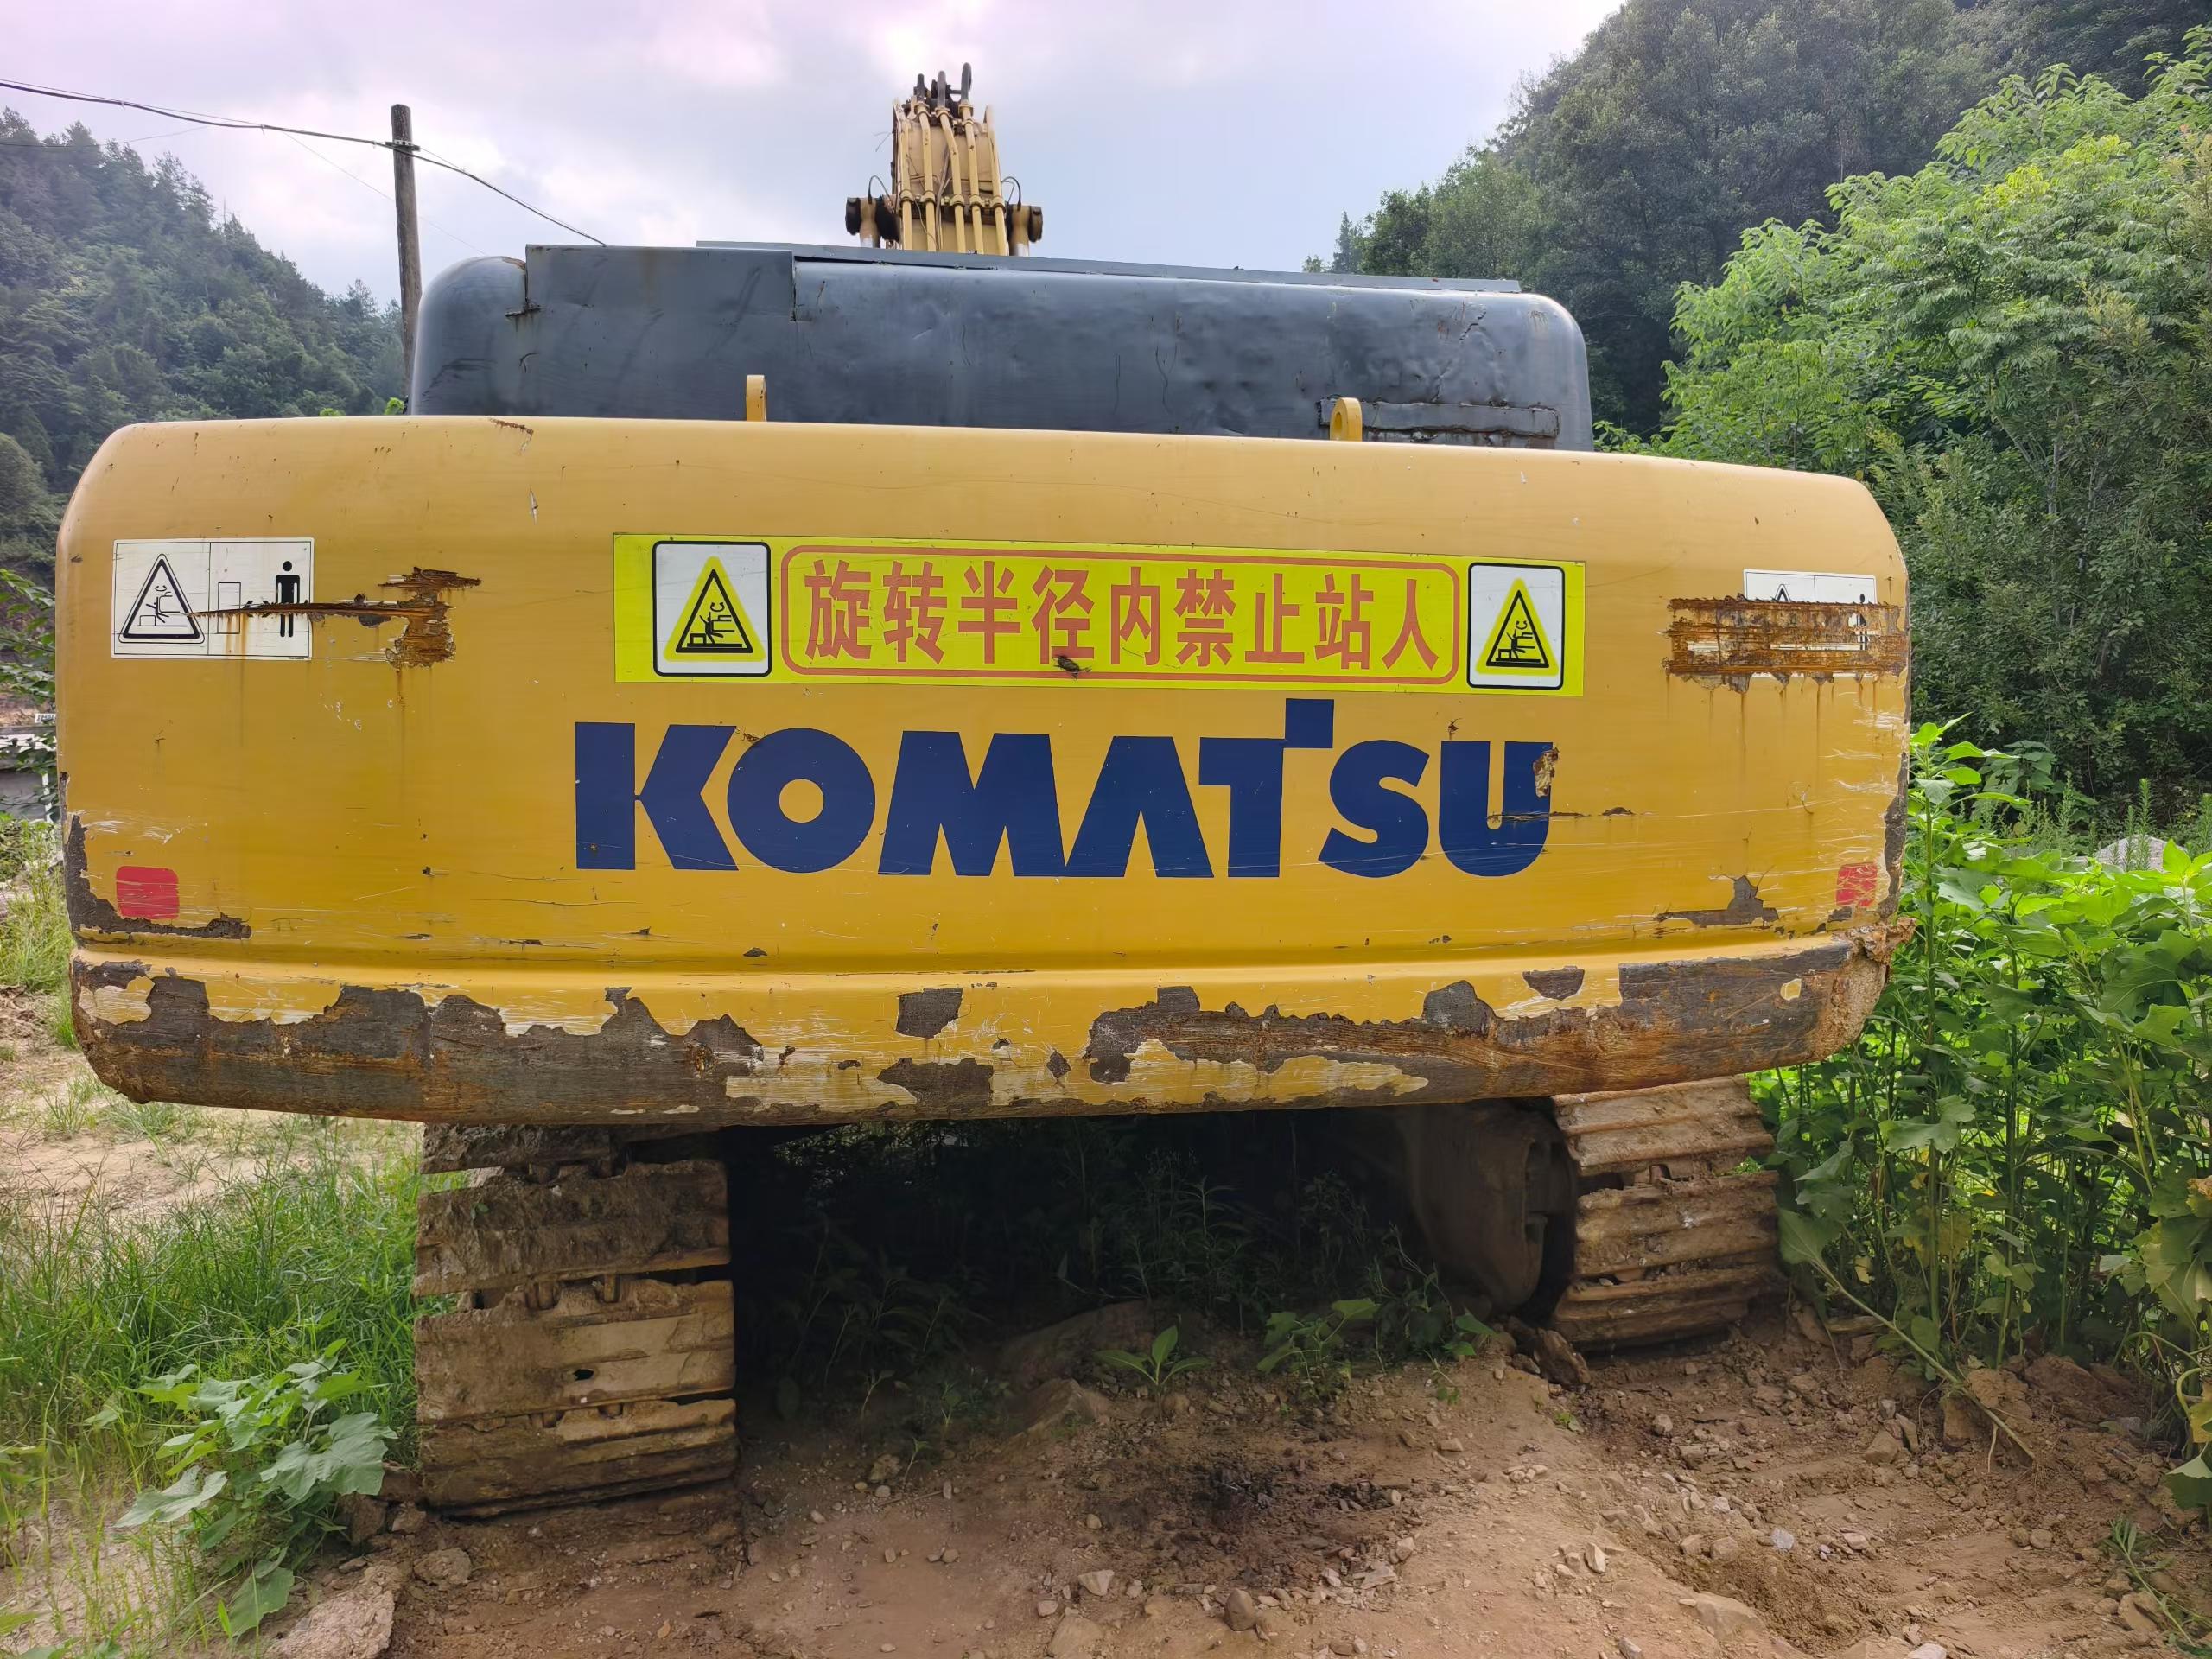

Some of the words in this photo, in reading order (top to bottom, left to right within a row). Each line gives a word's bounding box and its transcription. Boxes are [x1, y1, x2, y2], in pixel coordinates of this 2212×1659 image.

[804, 559, 1440, 671] 旋转半径内禁止站人
[575, 698, 1553, 877] KOMATSU
